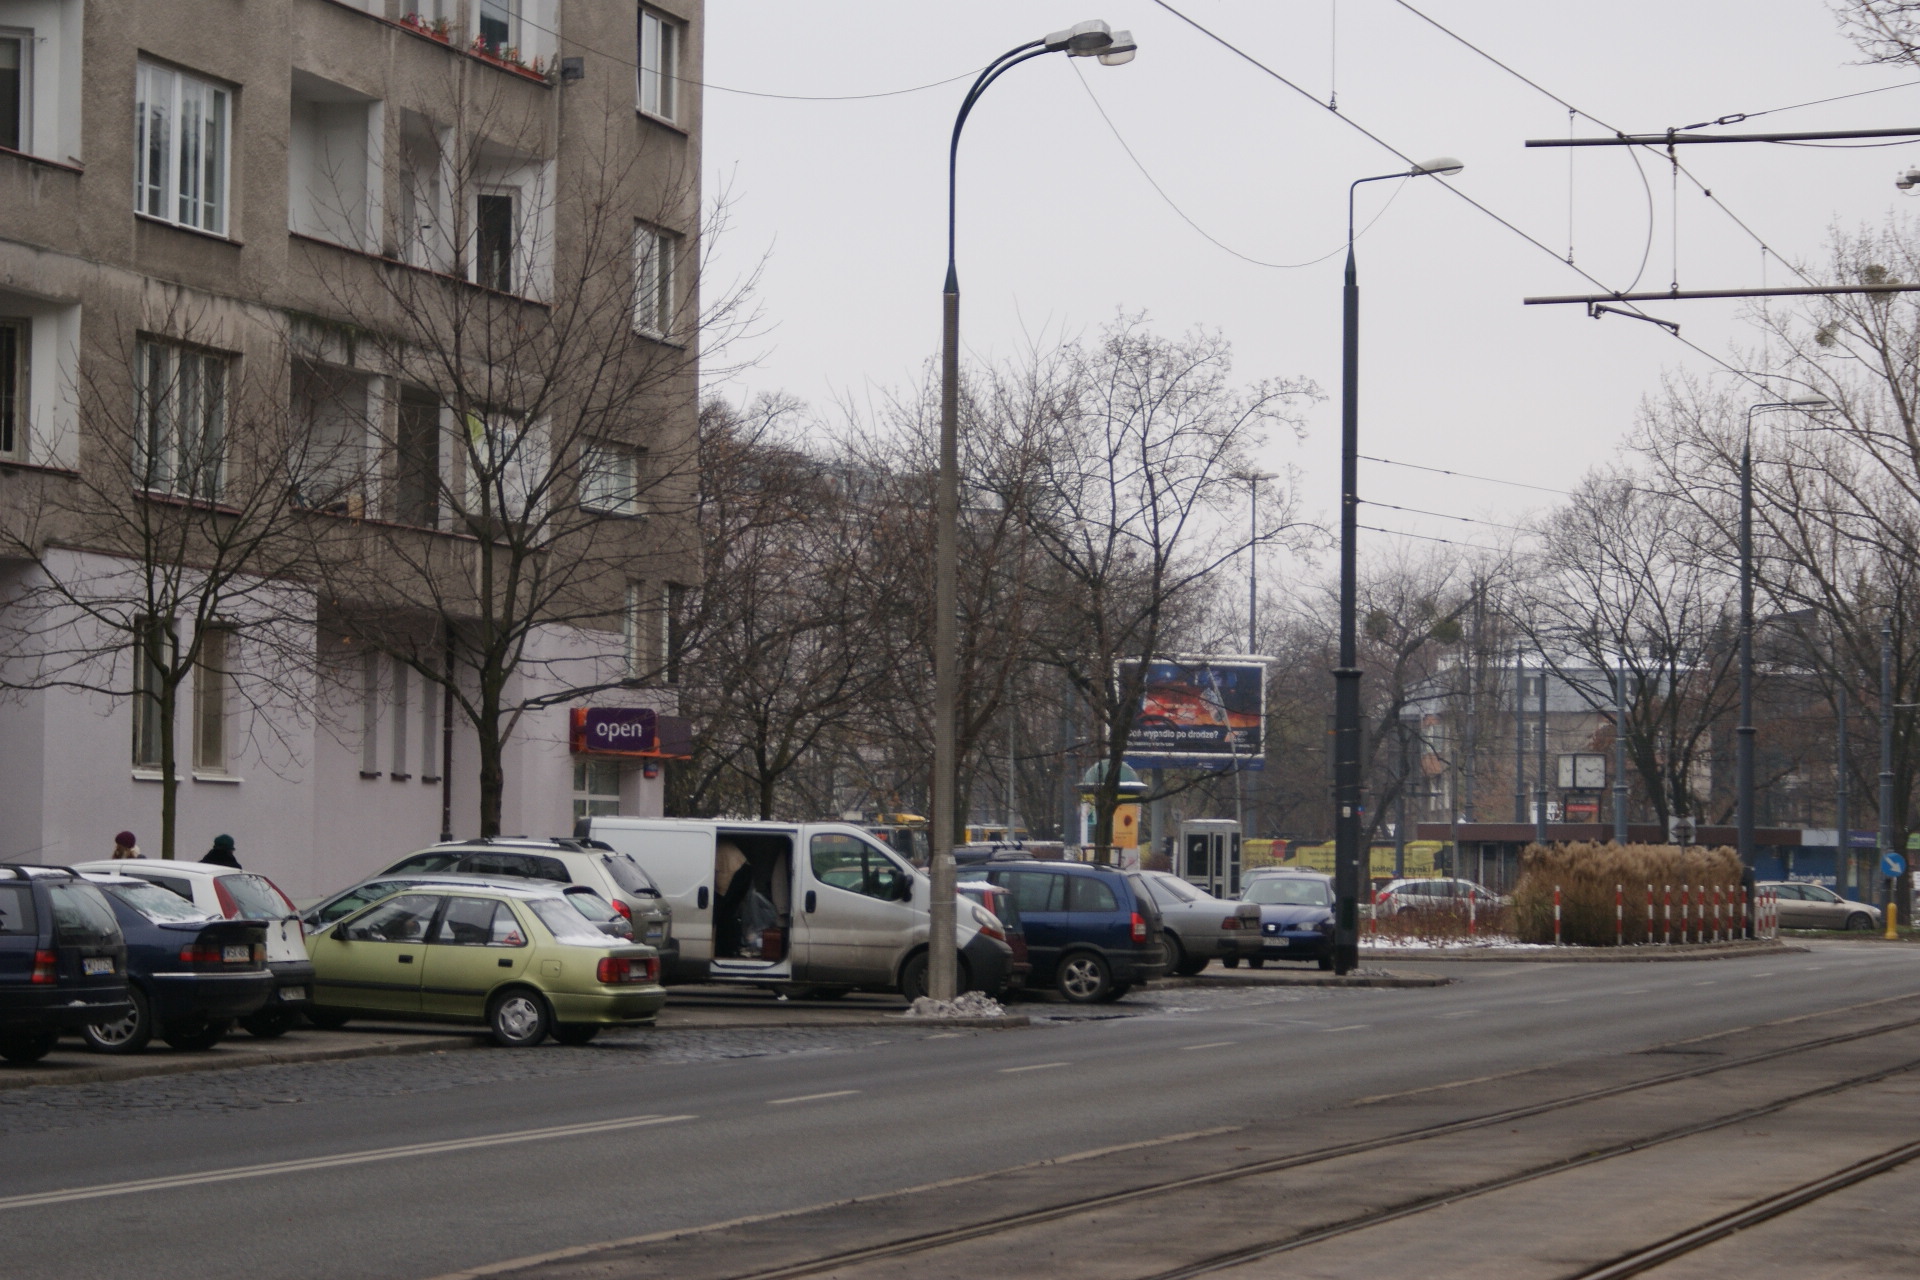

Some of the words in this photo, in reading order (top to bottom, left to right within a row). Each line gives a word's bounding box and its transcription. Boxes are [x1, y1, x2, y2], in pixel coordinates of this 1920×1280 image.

[596, 722, 642, 742] open
[1176, 731, 1187, 740] po
[1188, 730, 1219, 739] drodze?
